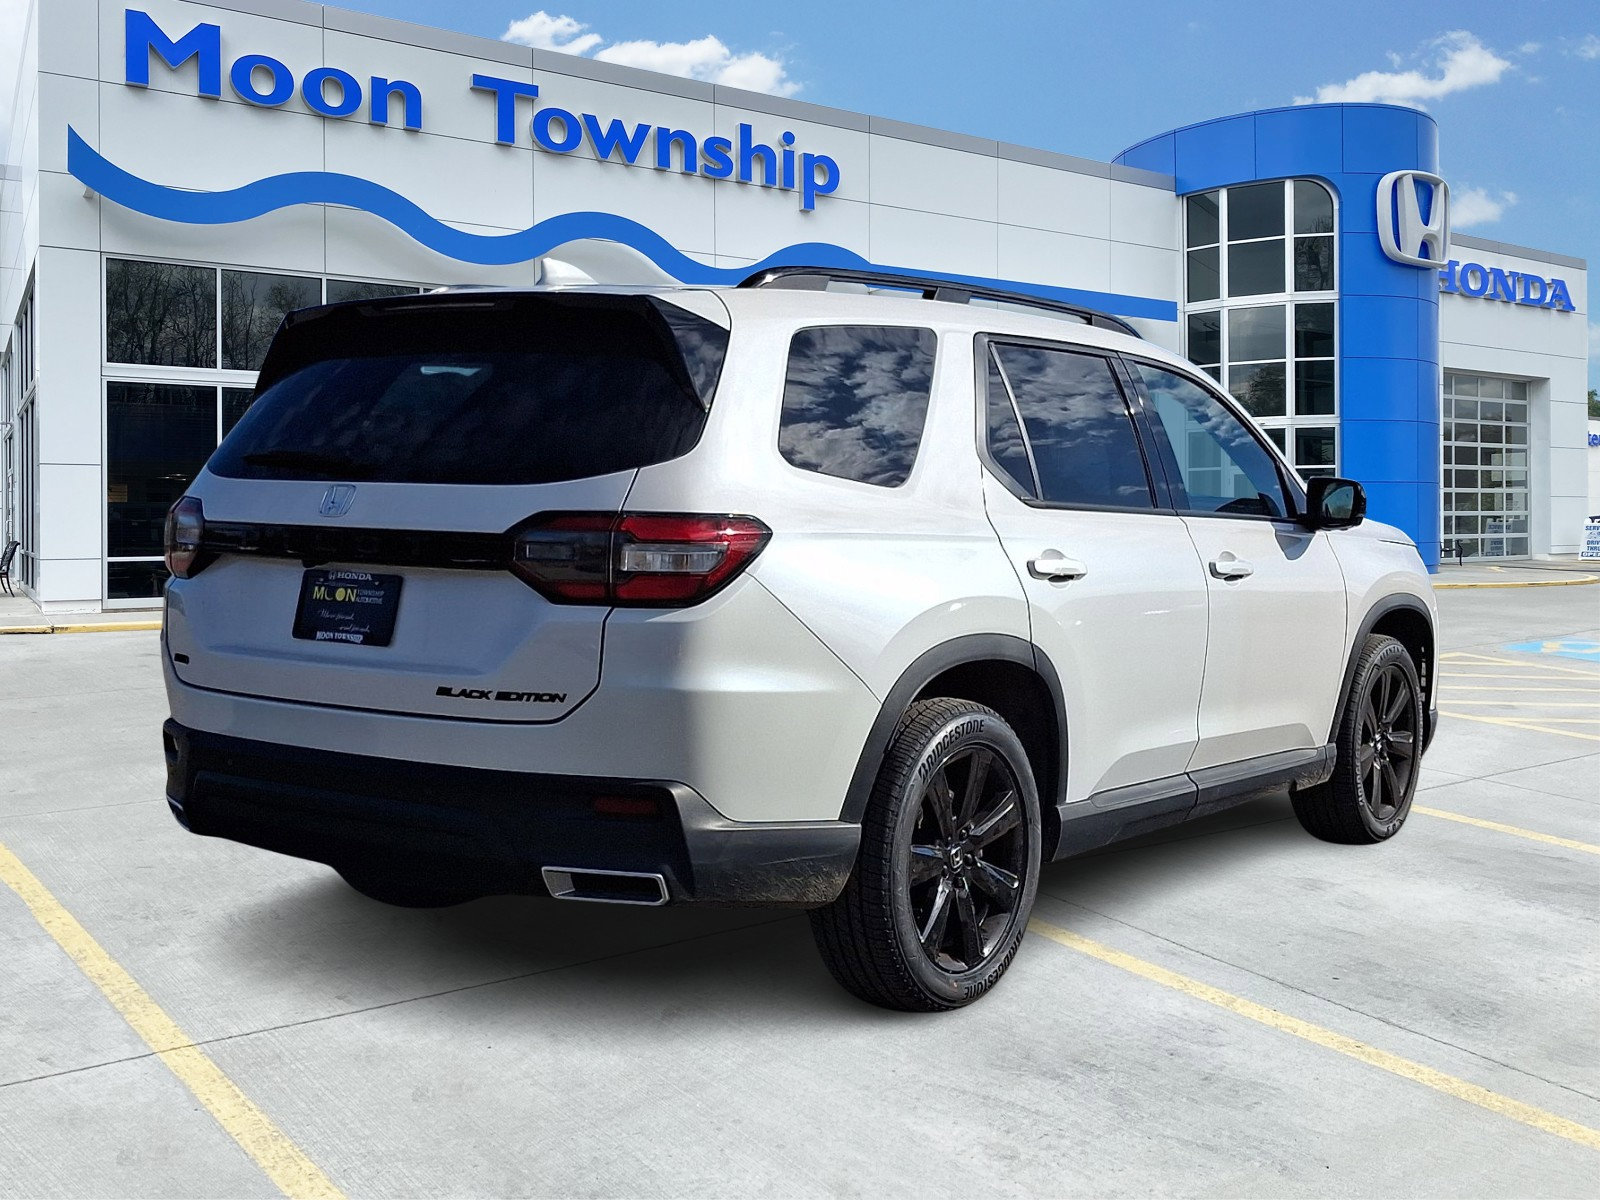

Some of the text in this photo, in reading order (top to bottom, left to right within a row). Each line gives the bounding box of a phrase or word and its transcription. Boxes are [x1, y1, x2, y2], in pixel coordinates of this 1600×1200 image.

[125, 9, 840, 212] Moon Township
[337, 571, 373, 581] HONDA
[313, 586, 357, 602] MOON
[436, 686, 567, 703] BLACK EDITION
[917, 719, 985, 785] BRIDGESTONE
